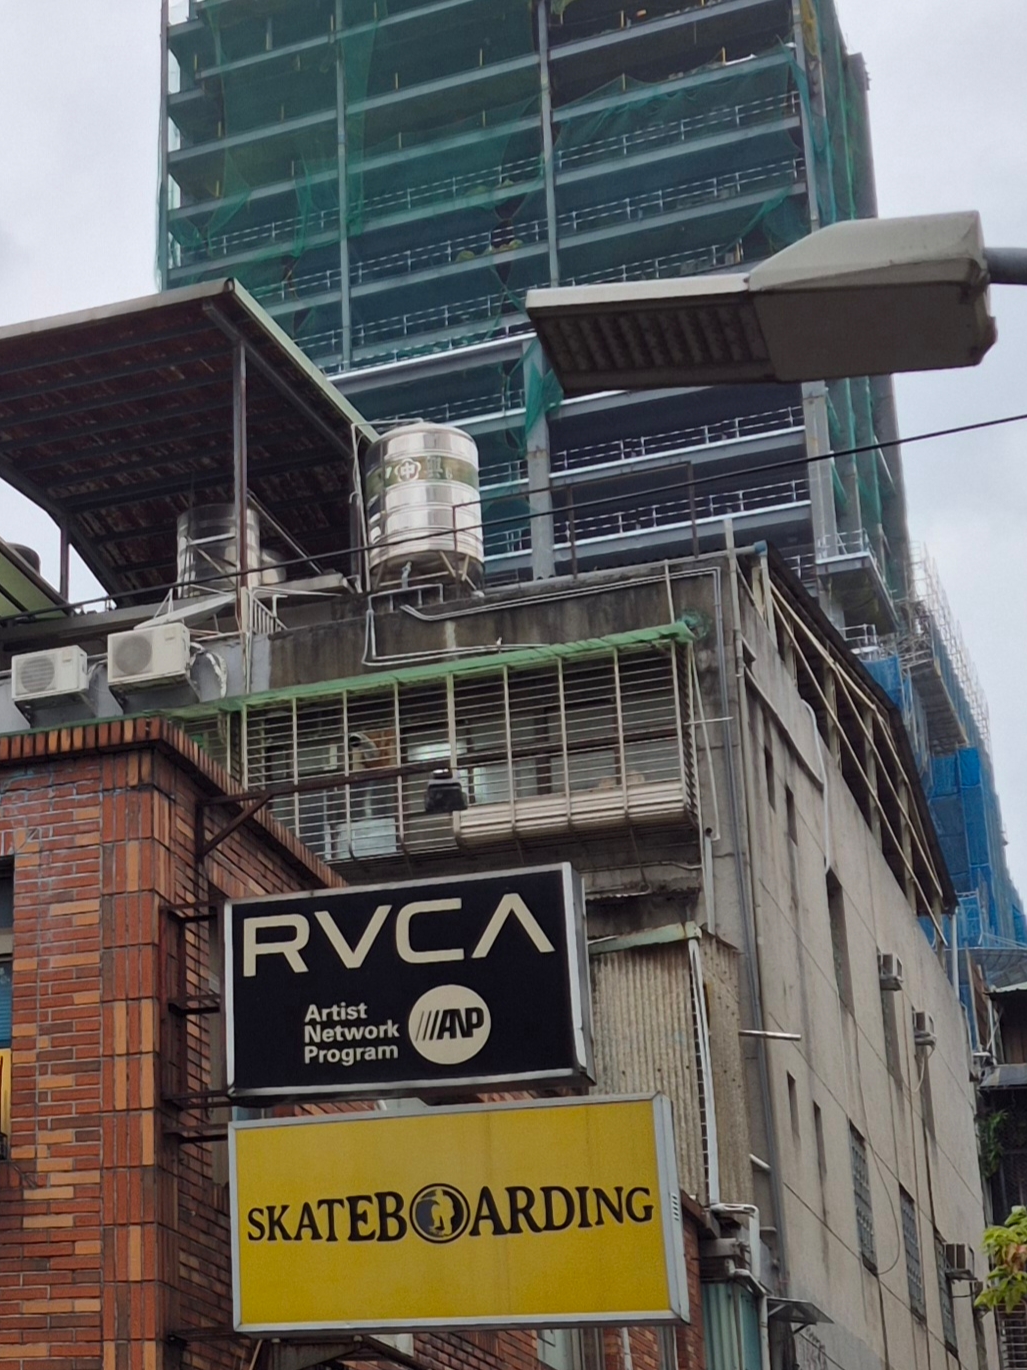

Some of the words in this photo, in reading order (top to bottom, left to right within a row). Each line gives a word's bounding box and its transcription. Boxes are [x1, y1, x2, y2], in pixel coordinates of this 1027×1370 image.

[243, 893, 556, 977] RVCA
[304, 1002, 368, 1022] Artist
[304, 1020, 400, 1044] Network
[304, 1042, 399, 1066] Program
[247, 1182, 654, 1244] SKATEBOARDING
